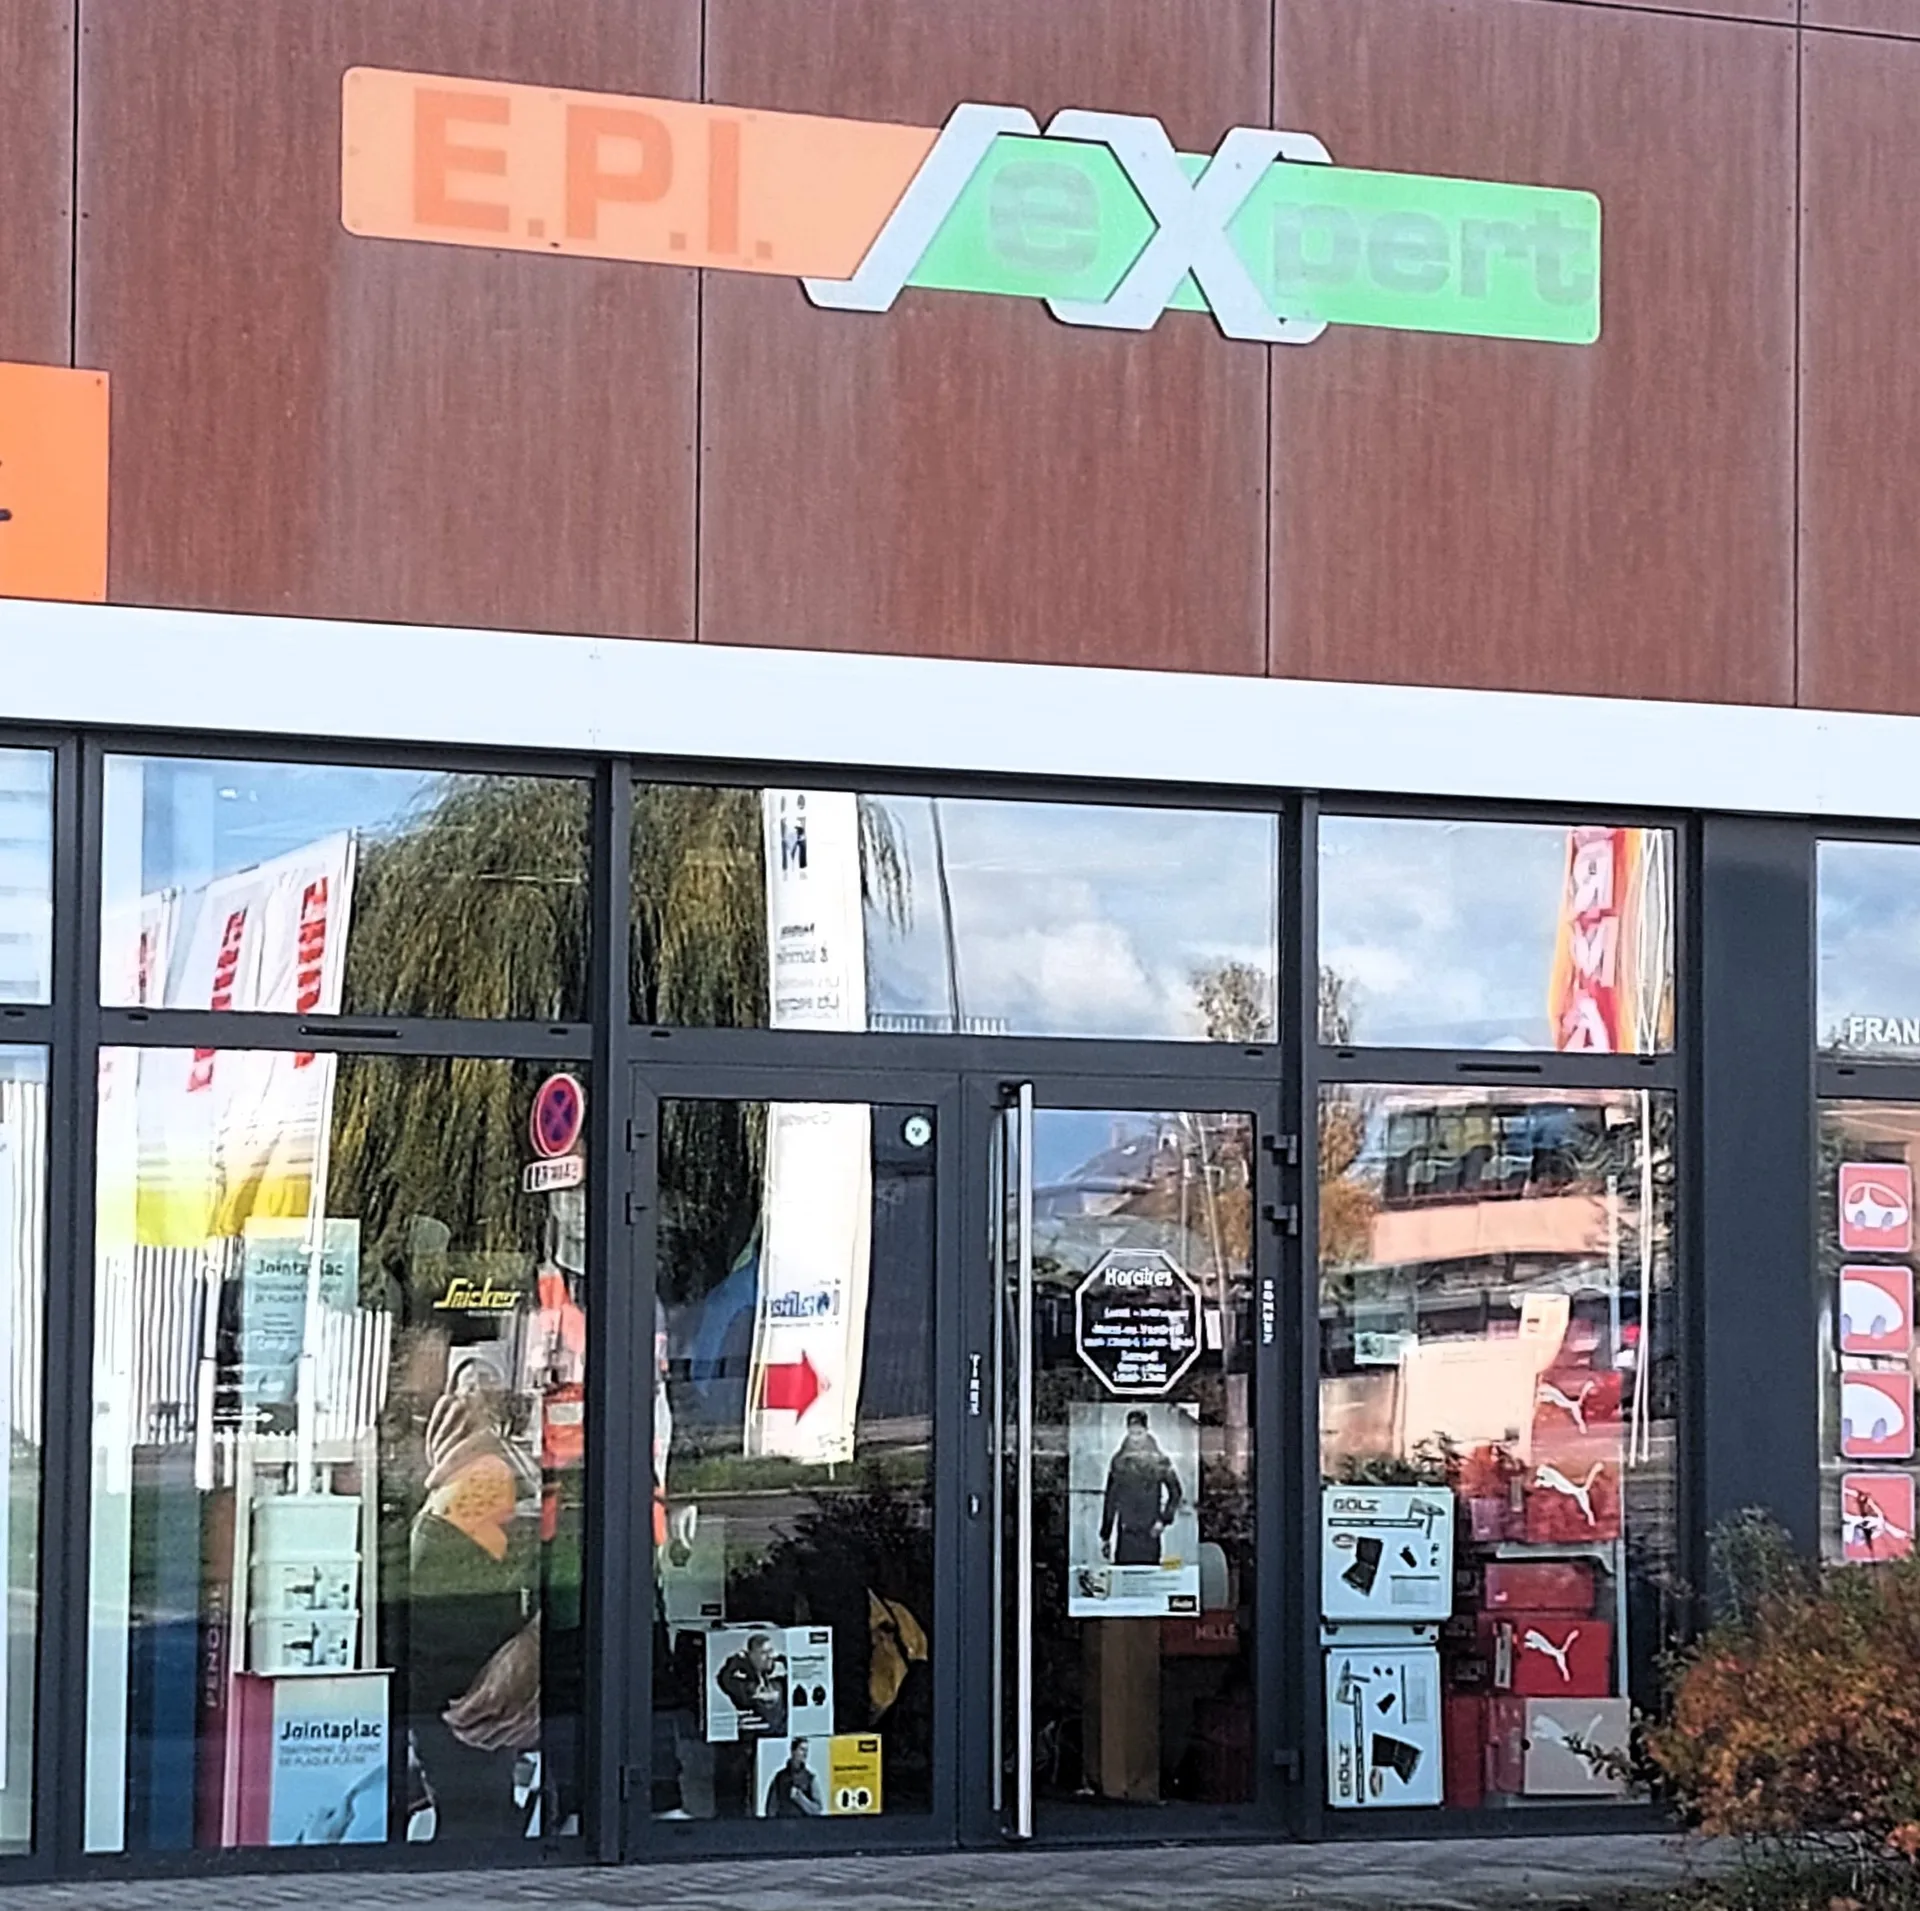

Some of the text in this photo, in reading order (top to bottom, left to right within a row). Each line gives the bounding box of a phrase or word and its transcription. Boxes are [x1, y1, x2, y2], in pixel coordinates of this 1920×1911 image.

[413, 87, 774, 261] E.P.I.
[1849, 1016, 1920, 1045] FRAN
[255, 1259, 344, 1277] Jointalac
[281, 1717, 382, 1743] Jointaplac
